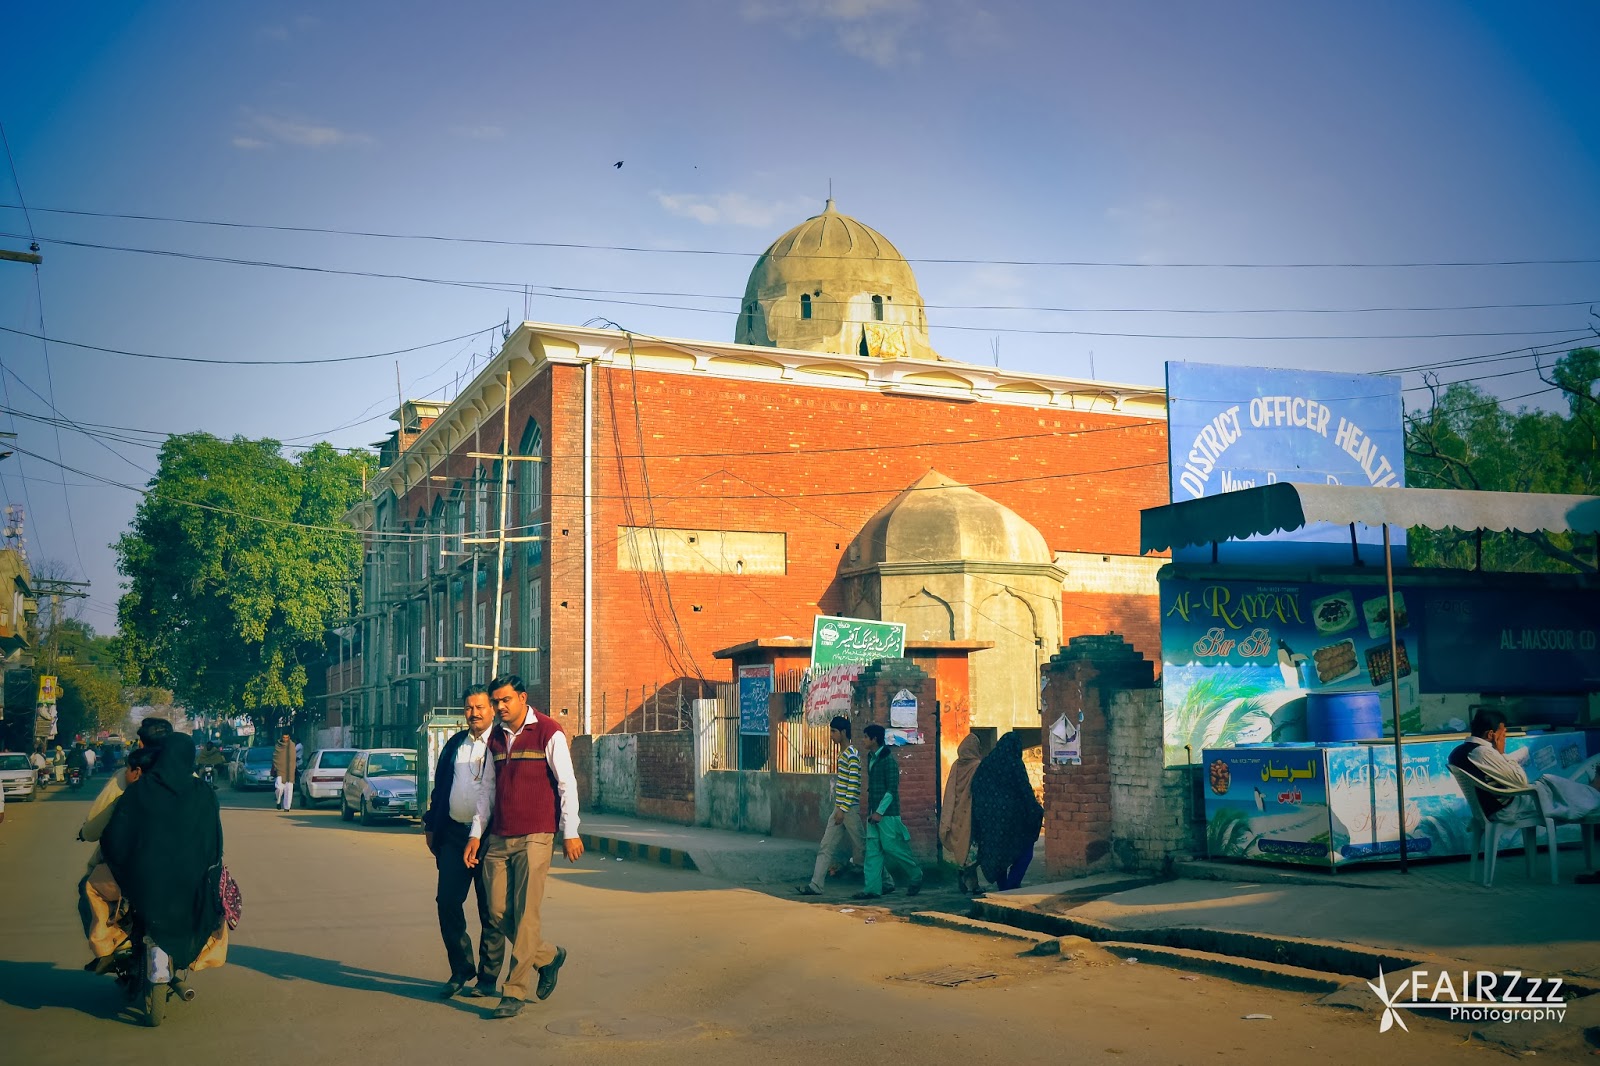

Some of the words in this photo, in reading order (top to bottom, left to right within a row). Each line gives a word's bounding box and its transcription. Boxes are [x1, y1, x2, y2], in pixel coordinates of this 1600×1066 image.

[1180, 405, 1242, 498] DISTRICT
[1250, 396, 1331, 438] OFFICER
[1334, 418, 1400, 487] HEALTH
[1193, 627, 1235, 657] Bar
[1500, 629, 1575, 650] AL-MASOOR
[1579, 629, 1597, 650] CD
